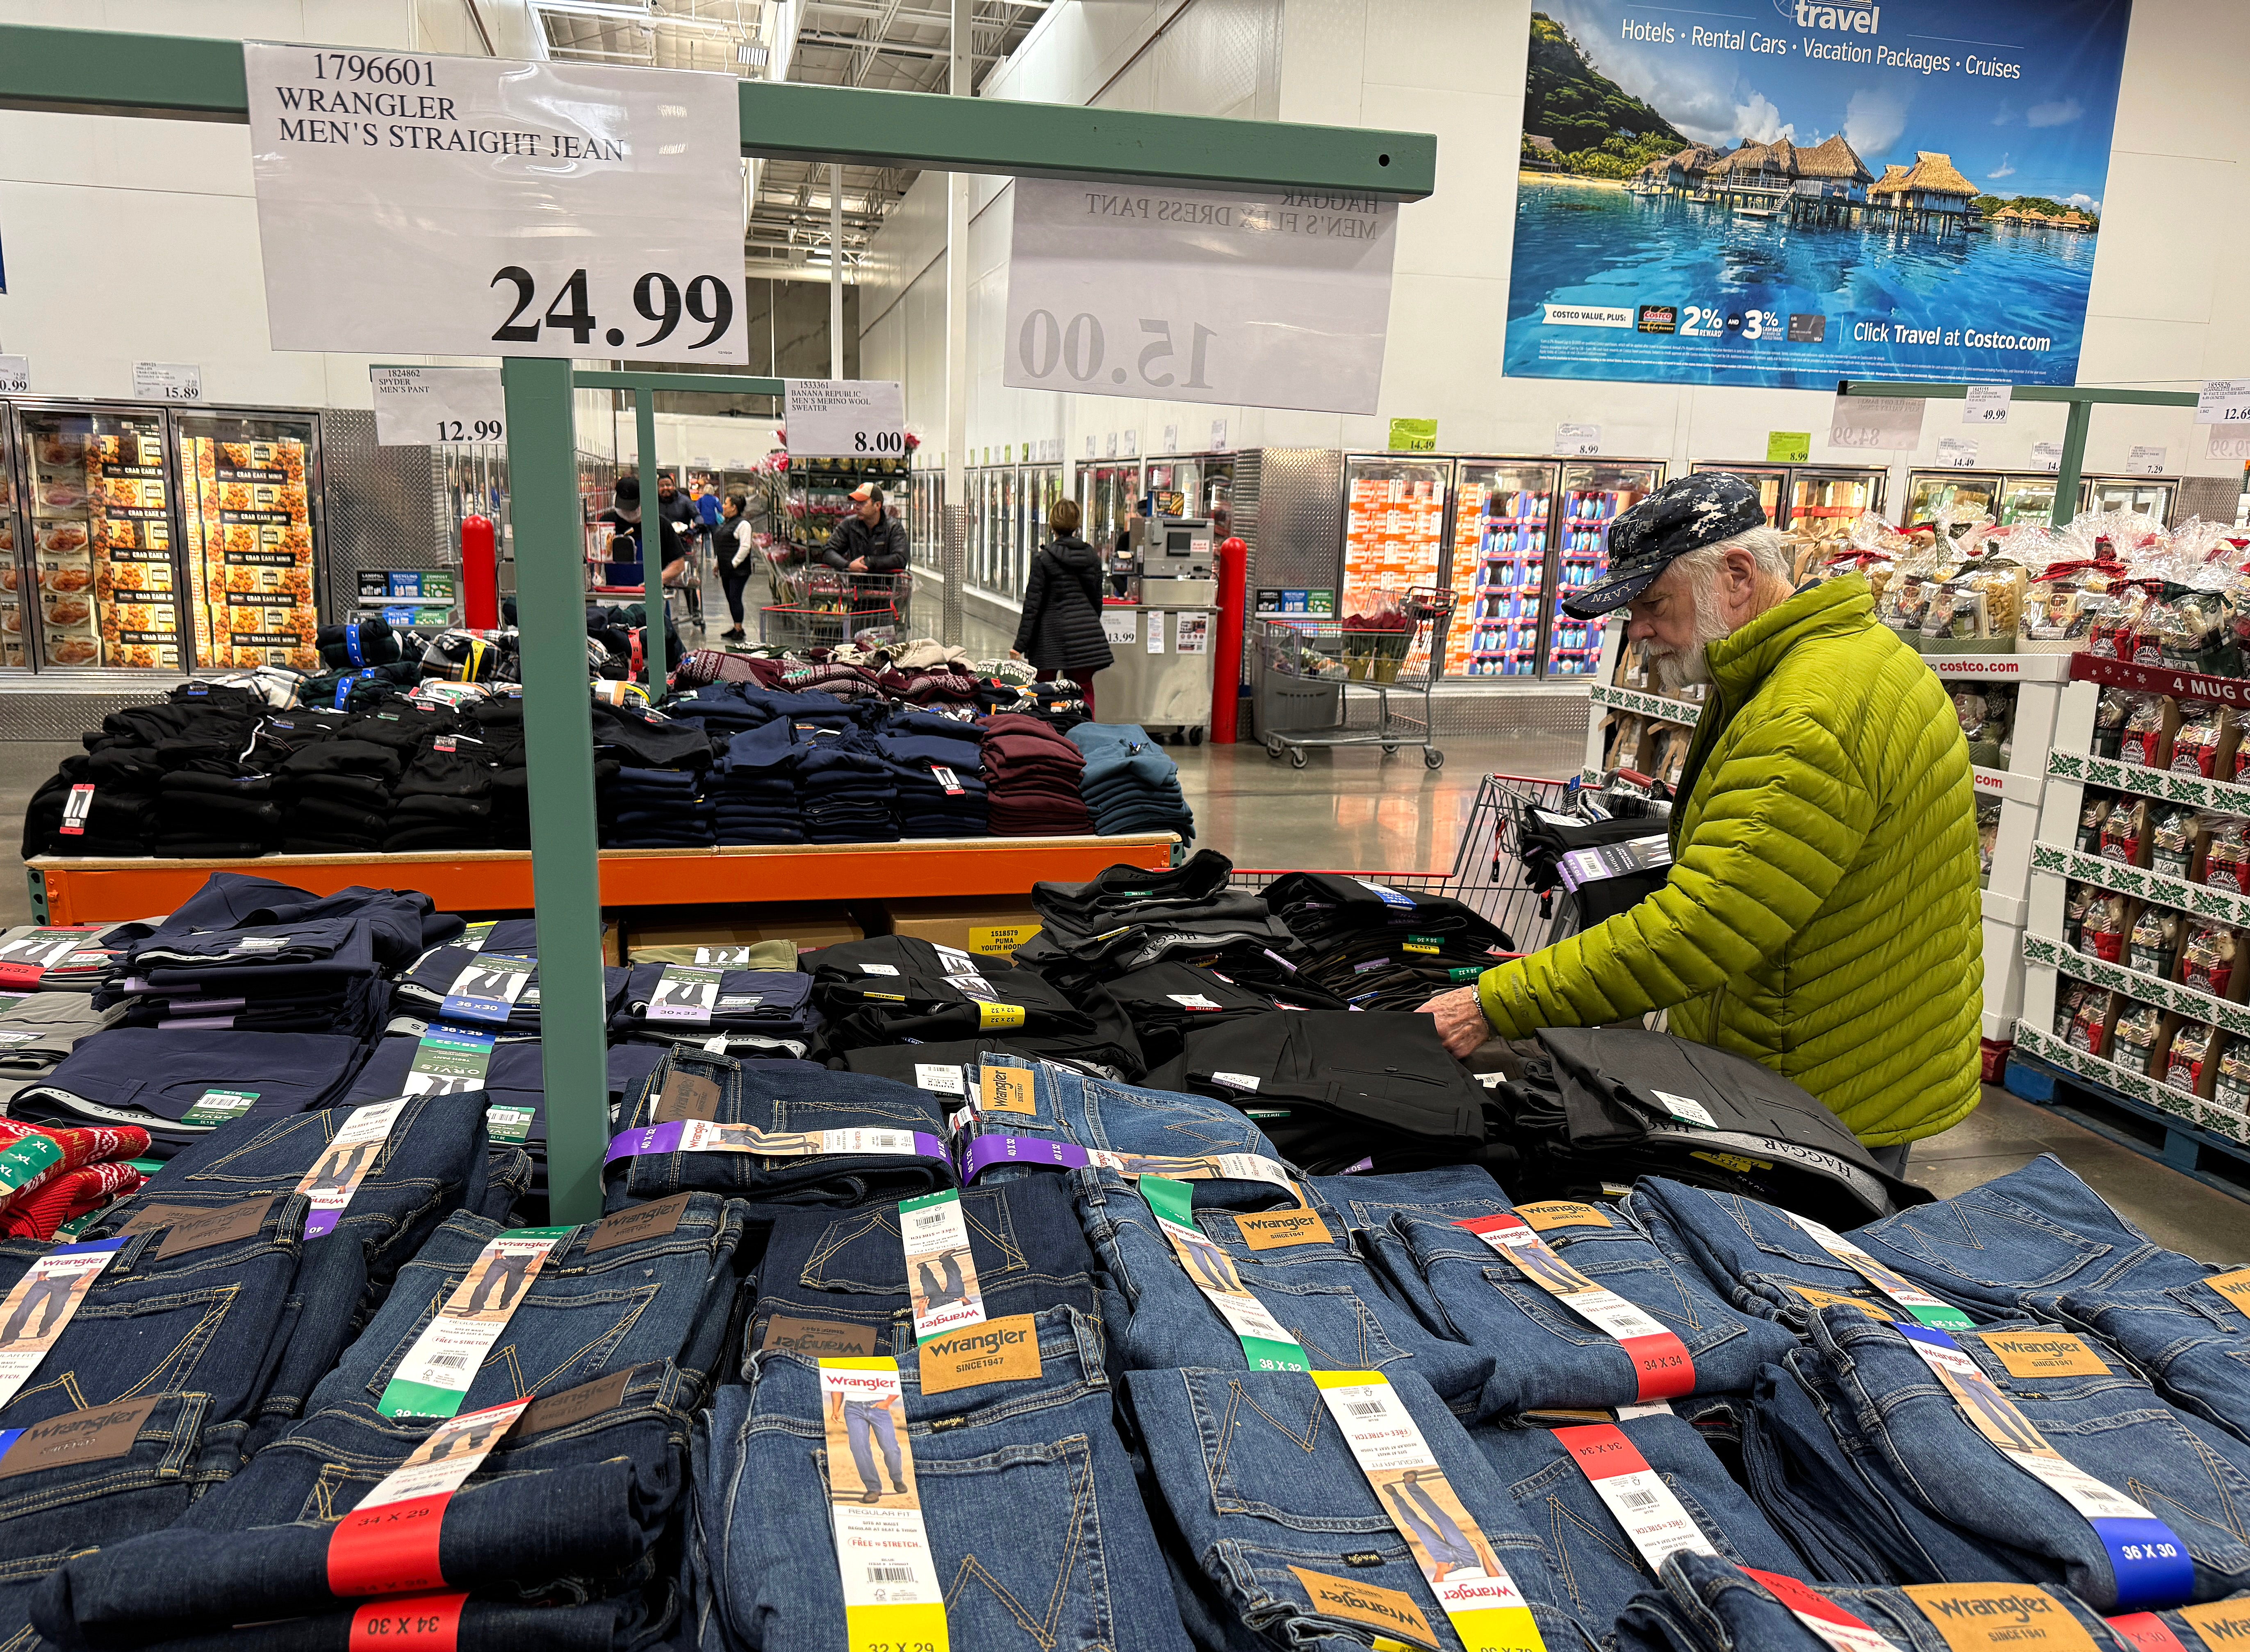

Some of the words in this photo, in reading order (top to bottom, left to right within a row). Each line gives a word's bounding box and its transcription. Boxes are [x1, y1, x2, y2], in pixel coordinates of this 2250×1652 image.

[1795, 0, 1880, 34] travel
[1622, 19, 1675, 43] Hotels
[1692, 26, 1744, 50] Rental
[1750, 32, 1786, 55] Cars
[1803, 37, 1871, 63] Vacation
[1877, 46, 1950, 75] Packages
[1965, 55, 2021, 80] Cruises
[314, 53, 436, 87] 1796601
[275, 87, 458, 120] WRANGLER
[278, 118, 378, 146] MEN'S
[389, 125, 541, 155] STRAIGHT
[551, 135, 624, 161] JEAN
[490, 266, 733, 349] 24.99
[1553, 310, 1579, 319] COSTCO
[1581, 312, 1605, 321] VALUE,
[1607, 313, 1626, 321] PLUS:
[1680, 306, 1722, 336] 2%
[1742, 310, 1779, 340] 3%
[1854, 322, 1888, 342] Click
[1894, 325, 1940, 345] Travel
[1945, 331, 1959, 346] at
[1964, 329, 2050, 351] Costco.com
[165, 387, 198, 398] 15.89
[1983, 410, 2006, 420] 49.99
[437, 420, 503, 441] 12.99
[855, 432, 902, 451] 8.00
[1411, 440, 1434, 450] 14.49
[1580, 445, 1598, 454] 8.99
[1790, 452, 1808, 461] 8.99
[1954, 458, 1974, 467] 14.49
[2148, 465, 2163, 474] 7.29
[1591, 582, 1632, 604] NAVY
[1108, 633, 1134, 643] 13.99
[2148, 646, 2161, 661] FRESH
[1940, 661, 2019, 673] costco.com
[2173, 677, 2184, 691] 4
[2191, 679, 2236, 700] MUG
[2186, 756, 2200, 769] FRESH
[1606, 850, 1621, 872] HAGGAR
[1143, 933, 1198, 956] HAGGAR
[477, 963, 526, 973] ORVIS
[420, 1064, 480, 1074] ORVIS
[995, 1069, 1013, 1109] Wrangler
[671, 1078, 696, 1121] Wrangler
[688, 1121, 705, 1149] Wrangler
[32, 1140, 49, 1153] XL
[1765, 1140, 1851, 1179] HAGGAR
[607, 1203, 679, 1228] Wrangler
[1523, 1204, 1591, 1215] Wrangler
[1243, 1216, 1315, 1230] Wrangler
[1485, 1230, 1530, 1242] Wrangler
[43, 1257, 107, 1267] Wrangler
[920, 1308, 979, 1328] Wrangler
[930, 1329, 1026, 1358] Wrangler
[1998, 1340, 2080, 1357] Wrangler
[1644, 1360, 1657, 1371] 34
[1660, 1358, 1668, 1368] X
[1669, 1355, 1682, 1366] 34
[1918, 1347, 1972, 1365] Wrangler
[1259, 1358, 1273, 1369] 38
[1276, 1360, 1286, 1371] X
[826, 1375, 896, 1390] Wrangler
[932, 1415, 964, 1428] Wrangler
[1579, 1447, 1595, 1456] 34
[1595, 1445, 1607, 1453] X
[1607, 1442, 1622, 1451] 34
[358, 1516, 380, 1526] 34
[389, 1513, 399, 1521] X
[406, 1508, 429, 1519] 29
[848, 1508, 895, 1517] REGULAR
[2122, 1545, 2142, 1560] 36
[2141, 1544, 2157, 1558] X
[2156, 1543, 2177, 1558] 30
[1444, 1584, 1516, 1600] Wrangler
[1319, 1589, 1423, 1631] Wrangler
[1933, 1593, 2051, 1623] Wrangler
[367, 1619, 390, 1635] 30
[398, 1618, 410, 1633] X
[417, 1616, 440, 1632] 34
